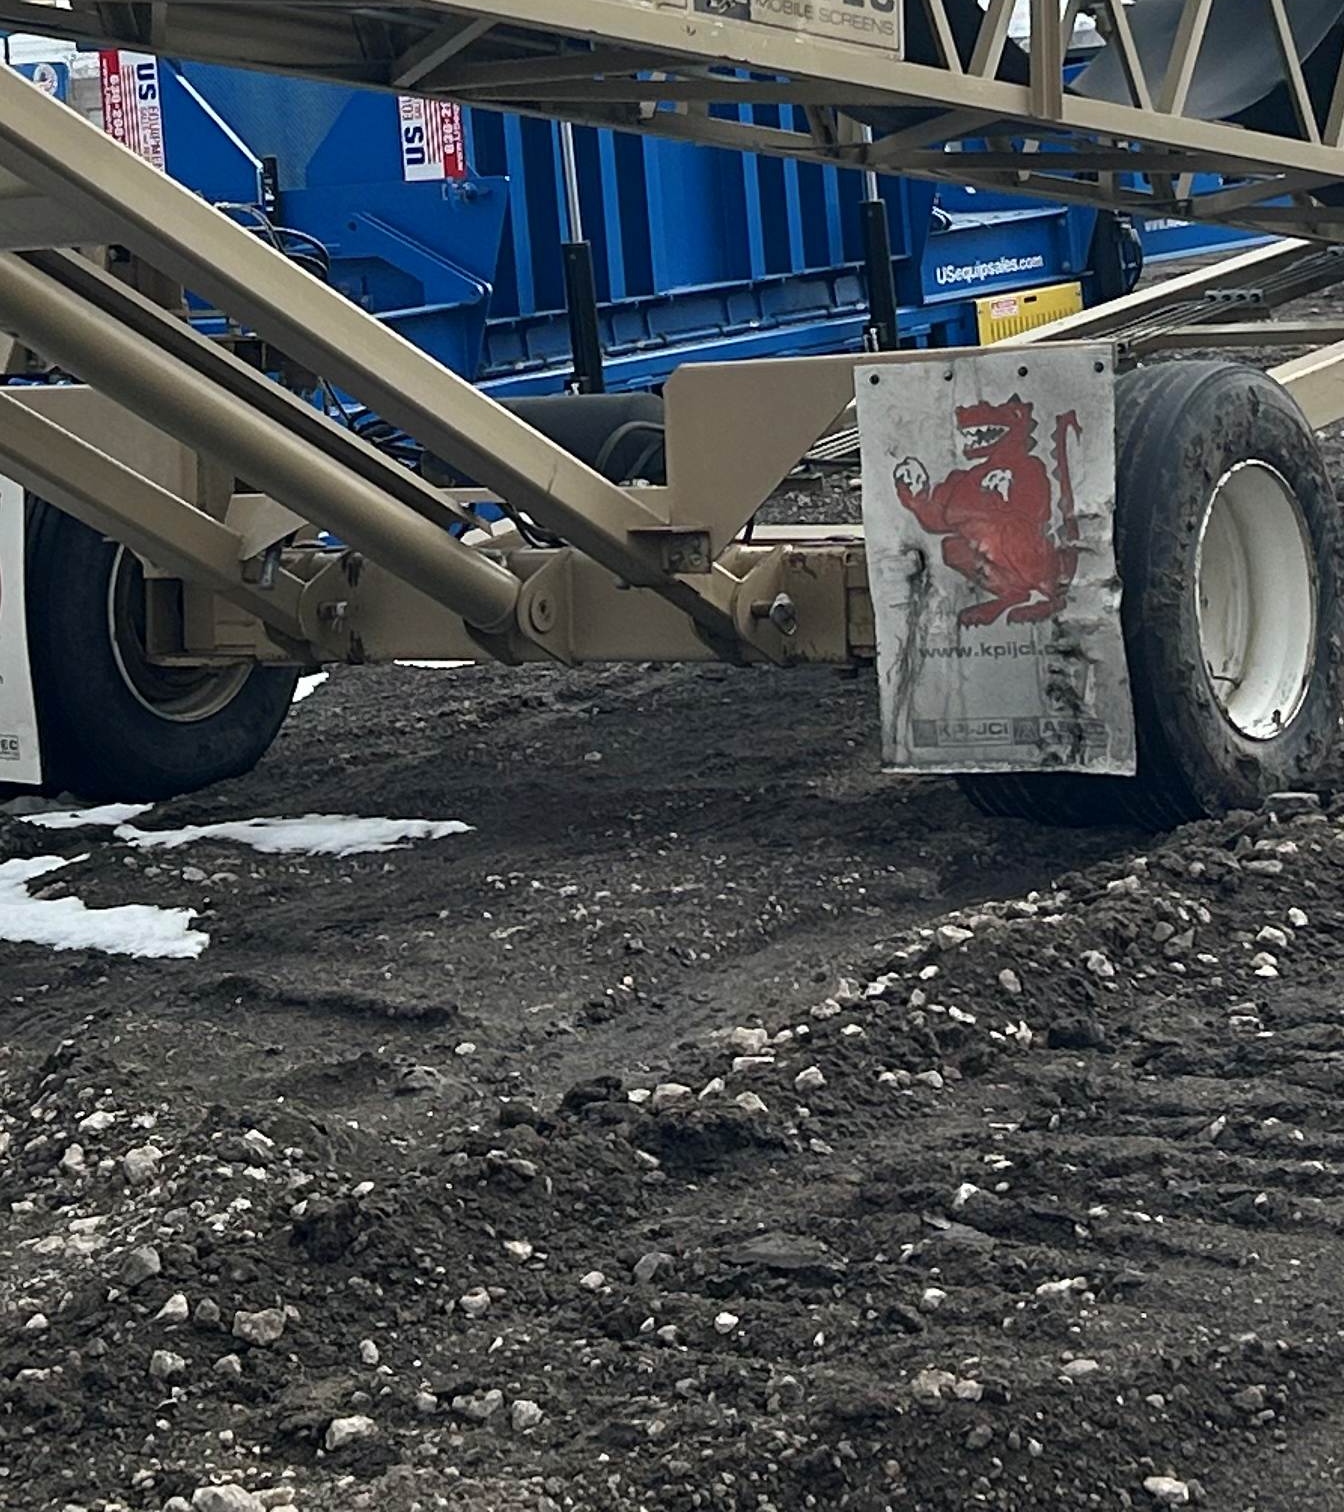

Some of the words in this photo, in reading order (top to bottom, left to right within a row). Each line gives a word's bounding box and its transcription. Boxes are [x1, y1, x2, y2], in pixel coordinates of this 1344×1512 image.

[817, 5, 895, 37] SCREENS
[137, 62, 156, 101] US
[404, 126, 426, 166] US
[936, 255, 1044, 285] USequipsales.com
